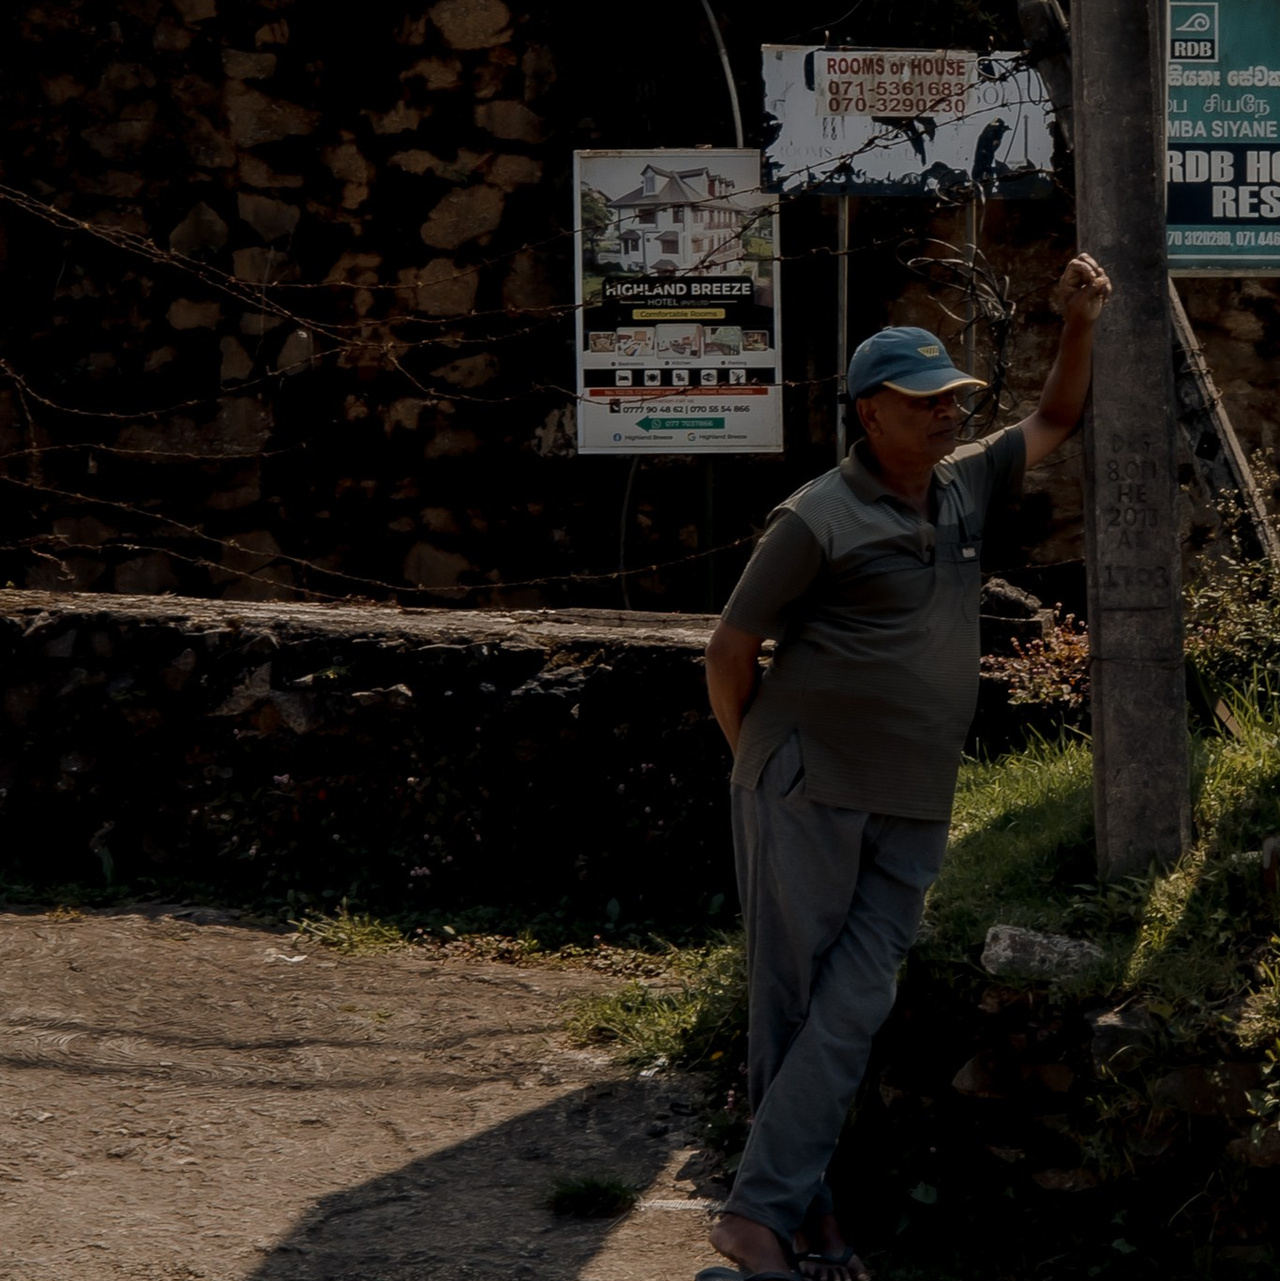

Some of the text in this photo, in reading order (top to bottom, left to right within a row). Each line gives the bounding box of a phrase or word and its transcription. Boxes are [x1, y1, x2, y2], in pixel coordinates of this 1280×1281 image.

[1174, 41, 1213, 57] RDB
[827, 58, 966, 76] ROOMS or HOUSE
[828, 81, 966, 97] 071-5361683
[828, 98, 966, 113] 070-3290230
[1167, 121, 1207, 137] MBA
[1211, 120, 1278, 138] SIYANE
[1166, 150, 1235, 183] RDB
[1167, 231, 1182, 246] 70
[1236, 231, 1255, 246] 071
[605, 282, 752, 296] HIGHLAND BREEZE
[646, 298, 679, 306] HOTEL
[639, 310, 718, 318] Comfortable Rooms
